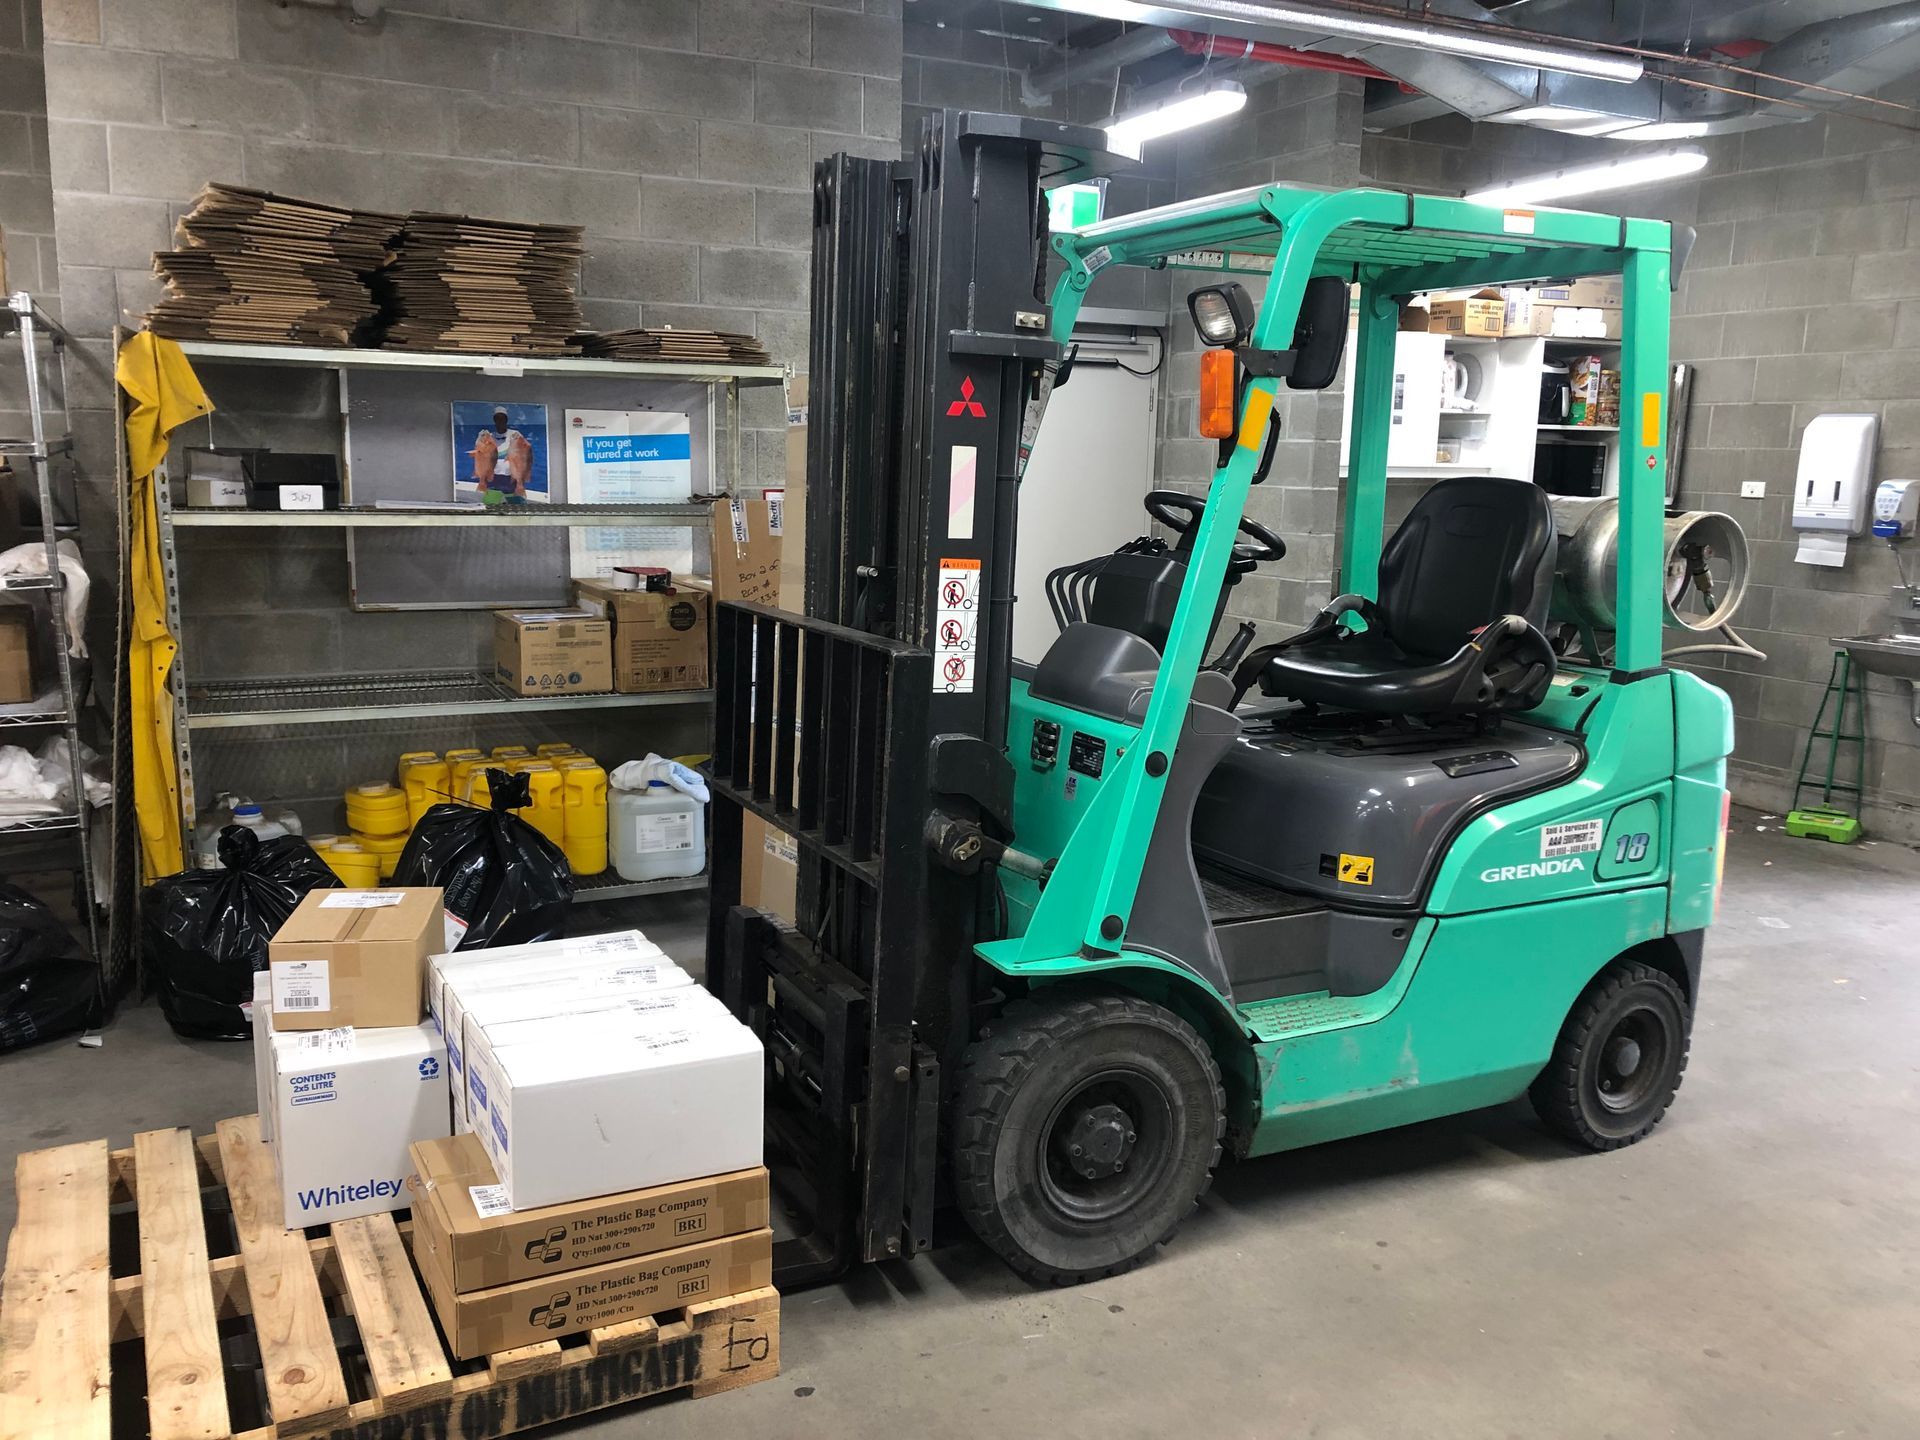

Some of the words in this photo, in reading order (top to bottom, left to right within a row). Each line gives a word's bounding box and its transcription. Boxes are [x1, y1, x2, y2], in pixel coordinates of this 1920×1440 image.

[586, 438, 594, 448] If
[595, 440, 614, 450] you
[616, 439, 632, 450] get
[587, 449, 621, 462] injured
[623, 449, 633, 458] at
[635, 448, 660, 458] work
[1614, 832, 1650, 864] 18
[289, 1071, 337, 1086] CONTENTS
[293, 1083, 310, 1093] 2x5
[311, 1080, 334, 1091] LITRE
[294, 1095, 321, 1103] AUSTRALIAN
[297, 1178, 403, 1211] Whiteley
[571, 1219, 594, 1231] The
[596, 1211, 632, 1226] Plastic
[635, 1207, 656, 1219] Bag
[658, 1196, 709, 1215] Company
[678, 1217, 703, 1233] BR1
[571, 1236, 586, 1246] HD
[588, 1232, 603, 1243] Nat
[604, 1222, 656, 1240] 300+290x720
[612, 1241, 631, 1251] /Ctn
[575, 1284, 598, 1297] The
[600, 1275, 636, 1291] Plastic
[638, 1269, 659, 1282] Bag
[661, 1257, 712, 1277] Company
[681, 1279, 706, 1295] BR1
[575, 1301, 590, 1311] HD
[592, 1297, 607, 1308] Nat
[608, 1285, 659, 1304] 300+290x720
[616, 1304, 634, 1315] /Ctn
[515, 1333, 704, 1430] MULTIGATE
